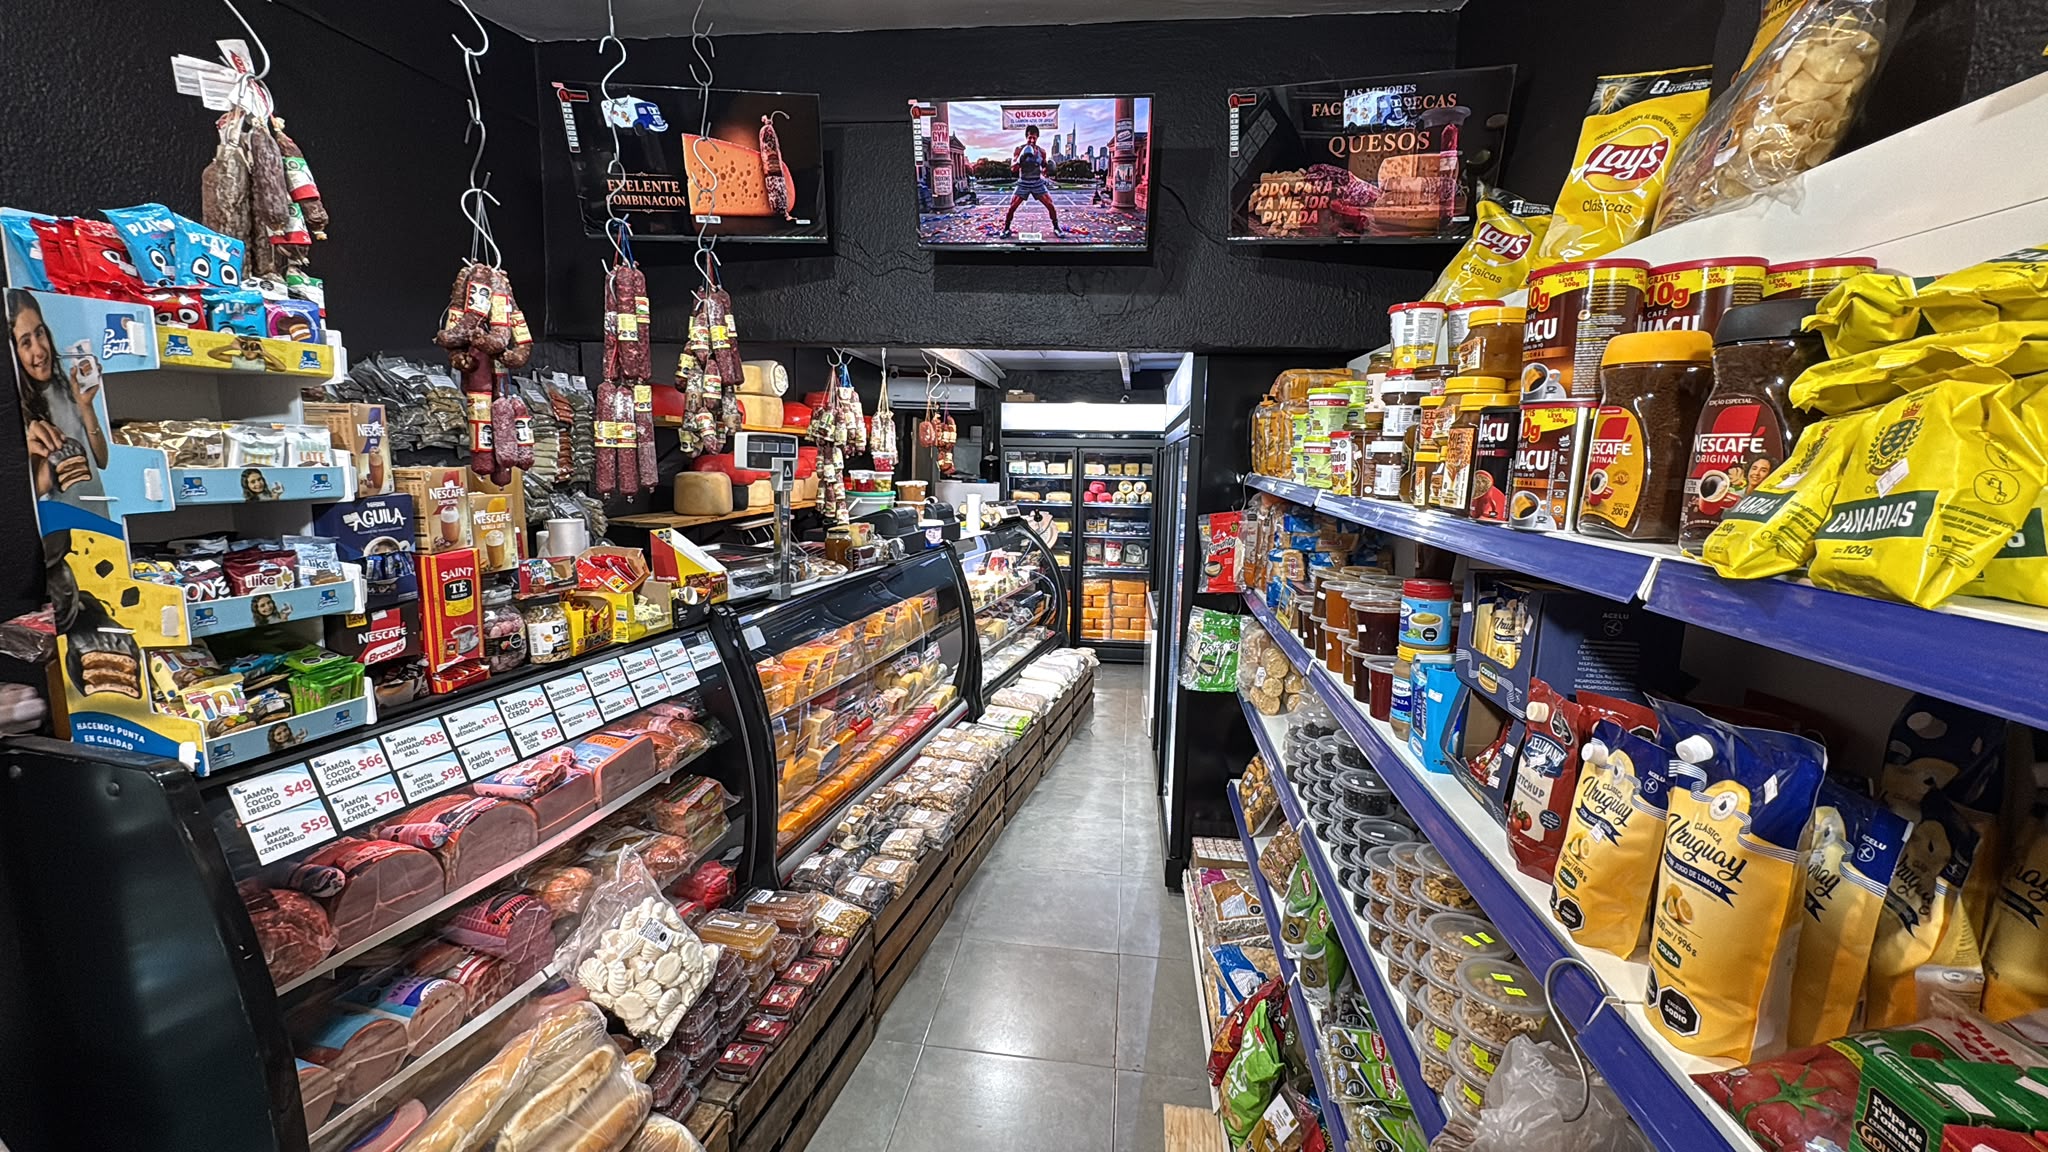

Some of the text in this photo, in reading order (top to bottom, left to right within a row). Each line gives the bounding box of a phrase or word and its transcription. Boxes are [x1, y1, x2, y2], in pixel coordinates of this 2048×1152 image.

[932, 131, 949, 142] GYM
[1328, 131, 1431, 158] QUESOS
[1585, 141, 1664, 180] Lay's
[607, 179, 680, 194] EXELENTE
[1253, 180, 1333, 197] TODO PARA
[606, 195, 686, 207] COMBINACION
[1256, 196, 1329, 210] LA MEJOR
[1582, 198, 1632, 214] Clásicas
[1263, 210, 1318, 224] PICADA
[1477, 223, 1528, 255] Lay's
[1648, 272, 1681, 286] GRATIS
[1768, 277, 1786, 285] LEVE
[1530, 286, 1551, 312] 0g
[1647, 282, 1690, 309] 10g
[1647, 308, 1669, 318] CAFÉ
[1522, 417, 1541, 443] 0g
[1592, 434, 1633, 456] ESCAFÉ
[1692, 426, 1764, 453] NESCAFÉ
[1695, 454, 1748, 465] ORIGINAL
[1611, 507, 1623, 516] 200
[1825, 500, 1918, 534] CANARIAS
[1843, 544, 1874, 558] 100g
[440, 567, 473, 582] SAINT
[450, 580, 468, 594] TÉ
[1602, 612, 1629, 620] ACELU
[368, 639, 404, 664] Brocafé
[609, 668, 623, 680] $59
[1481, 666, 1497, 681] COUSA
[575, 684, 587, 693] $29
[504, 699, 528, 713] QUESO
[507, 696, 545, 719] CERDO $45
[76, 722, 145, 744] HACEMOS PUNTA
[455, 714, 500, 739] MEDIACURA $125
[458, 720, 477, 732] JAMÓN
[84, 735, 134, 751] EN CALIDAD
[392, 731, 445, 756] AHUMADO $85
[394, 736, 417, 749] JAMÓN
[520, 730, 539, 741] SALAME
[526, 727, 558, 751] COCA $59
[404, 748, 420, 758] KALI
[467, 750, 492, 766] JAMÓN
[471, 745, 512, 771] CRUDO $199
[322, 758, 351, 775] JAMÓN
[325, 753, 384, 780] COCIDO $66
[325, 771, 362, 789] SCHNECK
[412, 772, 433, 786] JAMÓN
[417, 765, 462, 789] EXTRA $99
[243, 786, 274, 803] JAMÓN
[246, 779, 313, 808] COCIDO $49
[410, 780, 446, 798] CENTENARIO
[1518, 773, 1545, 799] ETCHUP
[248, 799, 281, 816] IBERICO
[341, 794, 368, 811] JAMÓN
[346, 788, 400, 815] EXTRA $76
[1582, 775, 1634, 828] Uruguay
[342, 806, 378, 825] SCHNECK
[264, 826, 290, 841] JAMÓN
[266, 815, 329, 846] MAGRO $59
[1694, 821, 1722, 845] CLÁSICA
[259, 834, 306, 856] CENTENARIO
[1667, 813, 1748, 883] Uruguay
[1673, 859, 1688, 875] JUGO
[1687, 868, 1698, 879] DE
[1697, 873, 1723, 894] LIMÓN
[1657, 940, 1679, 965] COUSA
[1677, 936, 1692, 953] 996
[1664, 1005, 1688, 1025] SODIO
[1666, 998, 1687, 1015] EXCESO
[1873, 1094, 1923, 1144] Pulpa de
